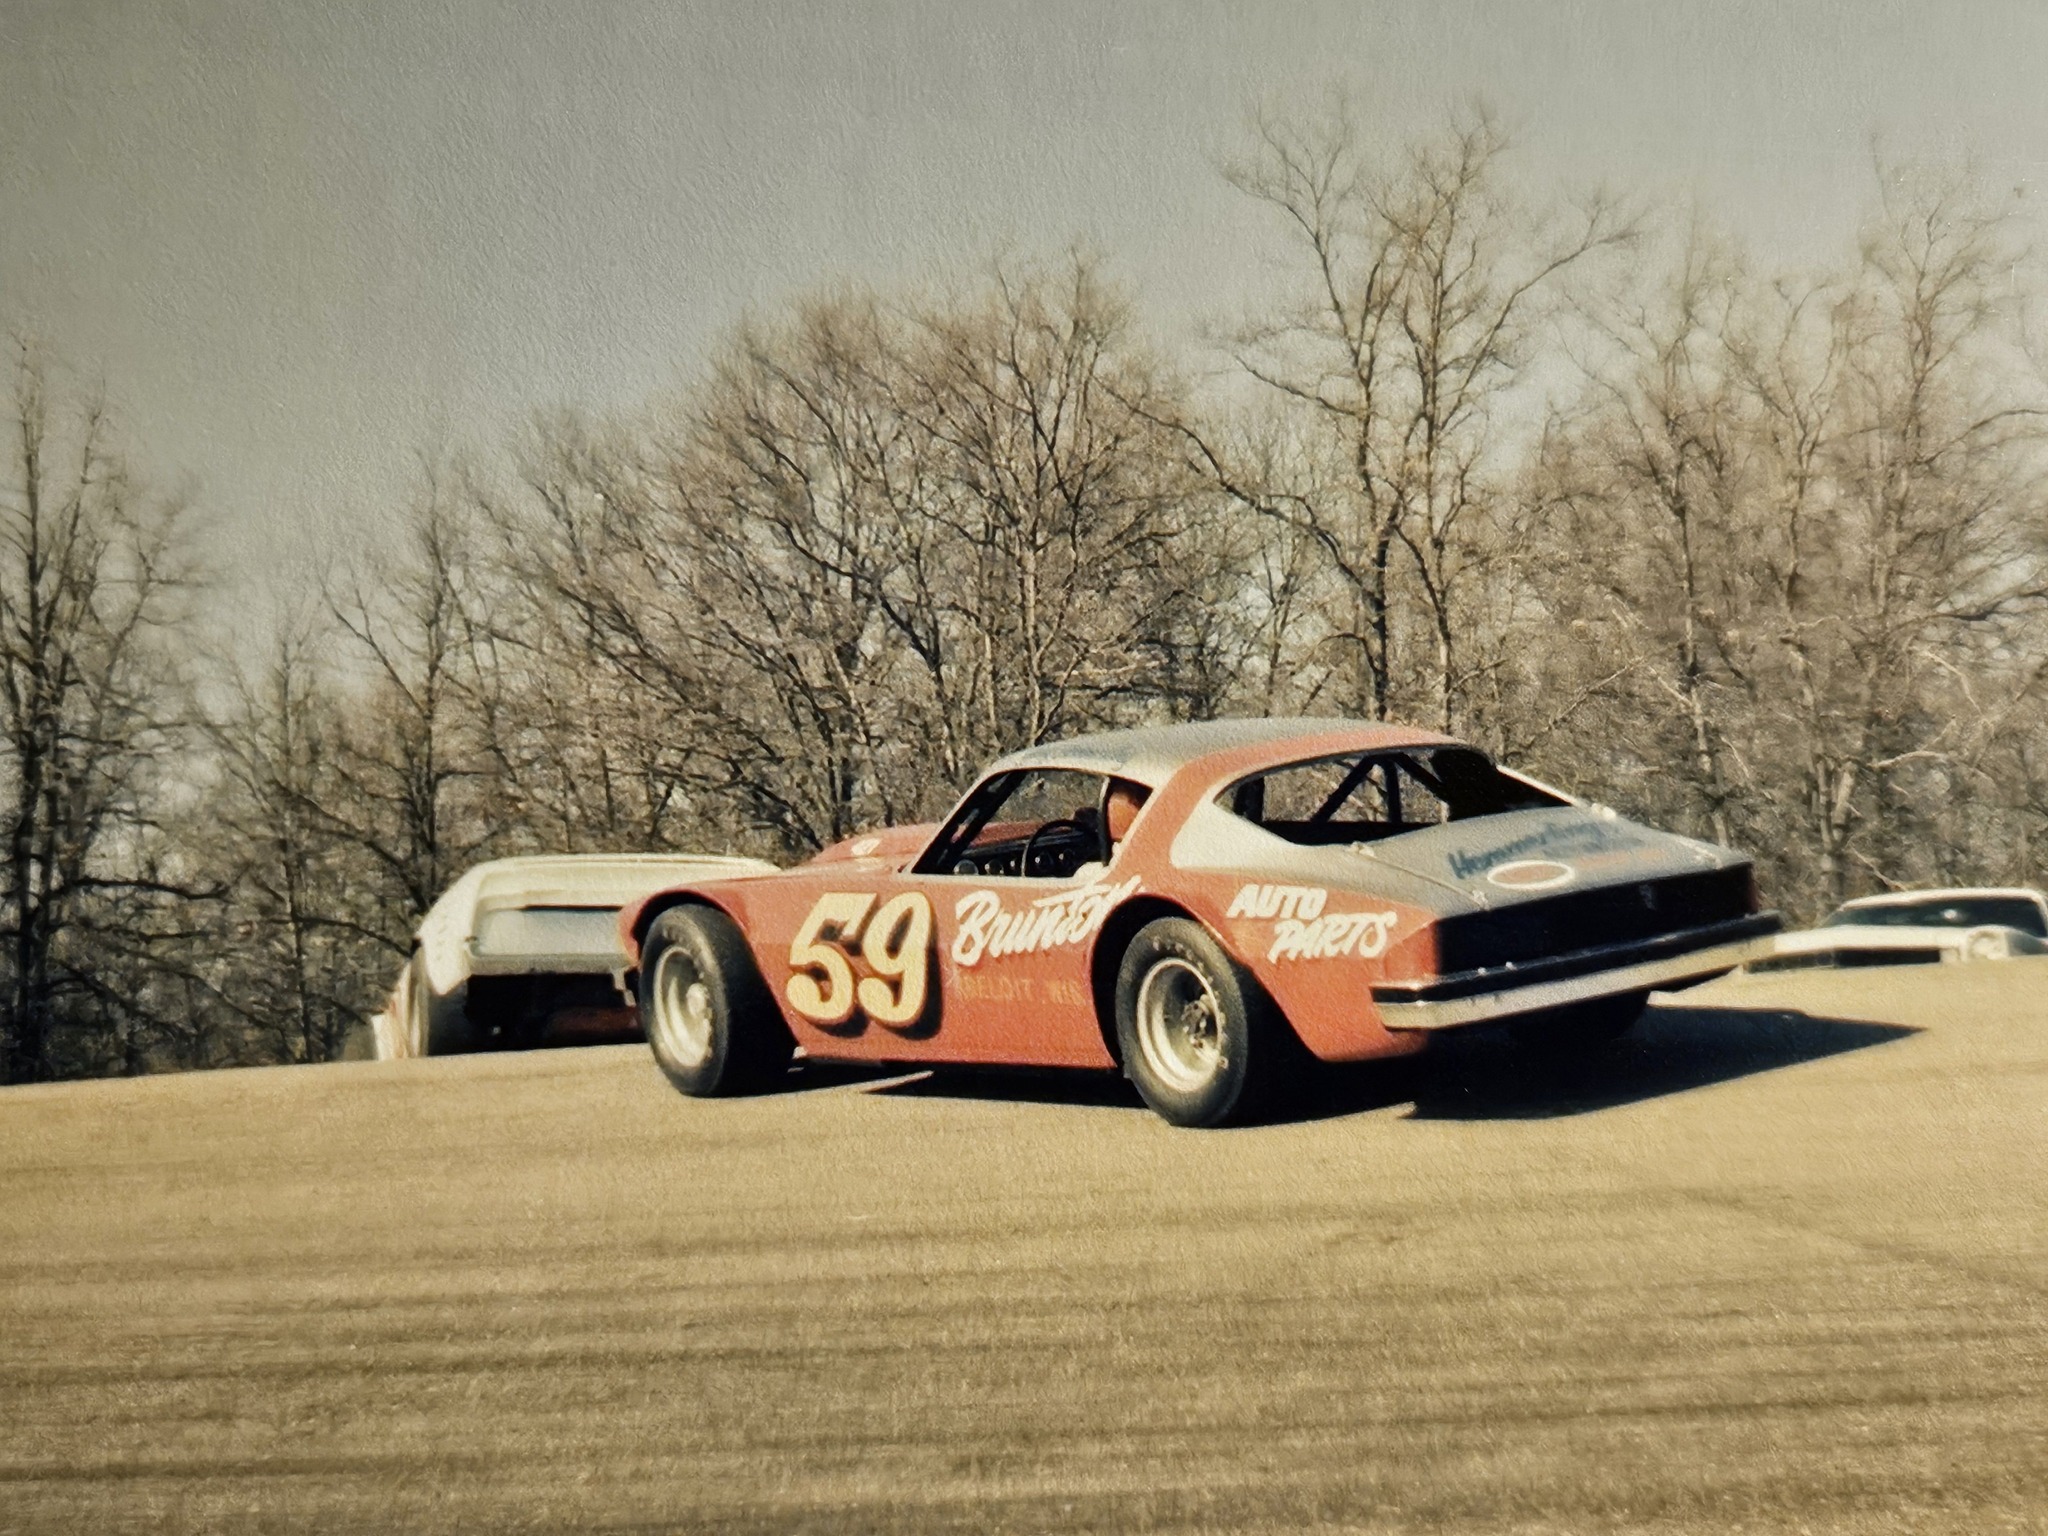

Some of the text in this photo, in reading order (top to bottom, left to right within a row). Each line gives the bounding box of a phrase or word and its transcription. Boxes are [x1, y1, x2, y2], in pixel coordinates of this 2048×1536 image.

[1226, 884, 1328, 920] AUTO
[785, 889, 936, 1028] 59
[1266, 910, 1398, 965] PARTS
